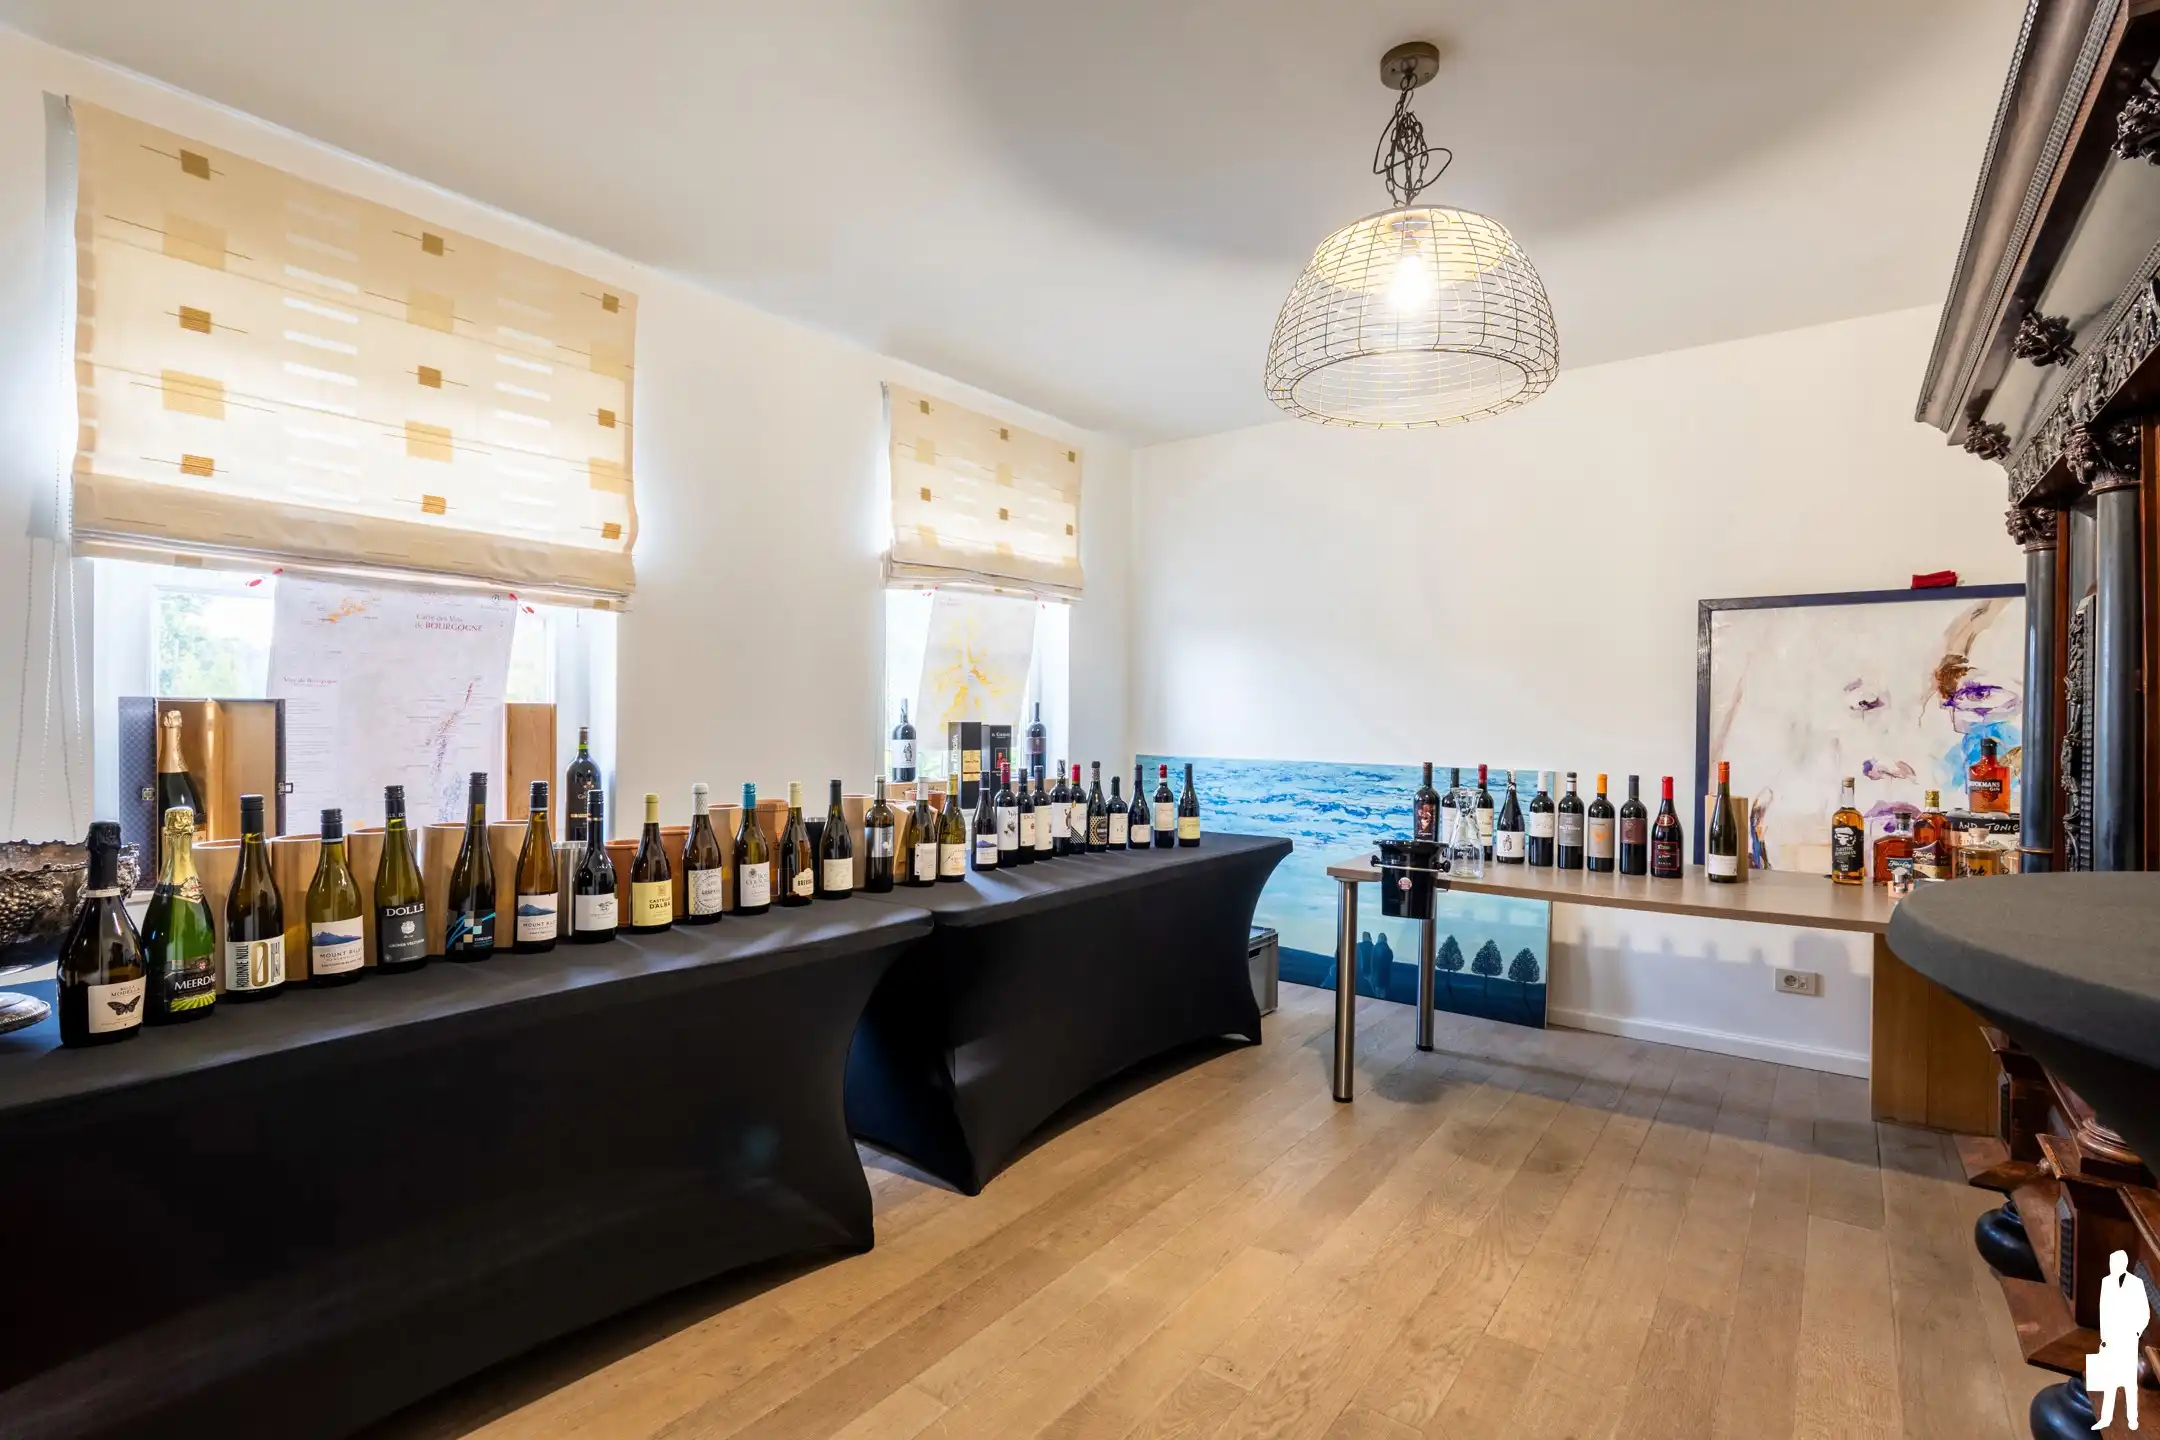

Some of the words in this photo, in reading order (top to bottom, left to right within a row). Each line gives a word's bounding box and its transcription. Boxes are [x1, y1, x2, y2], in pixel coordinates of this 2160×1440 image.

[425, 623, 484, 632] BOURGOGNE
[1959, 821, 1978, 829] AND
[1985, 822, 2020, 832] TONIC
[386, 903, 425, 917] DOLLE
[235, 944, 249, 960] NULL
[319, 950, 346, 959] MOUNT
[111, 988, 141, 997] MODELLA
